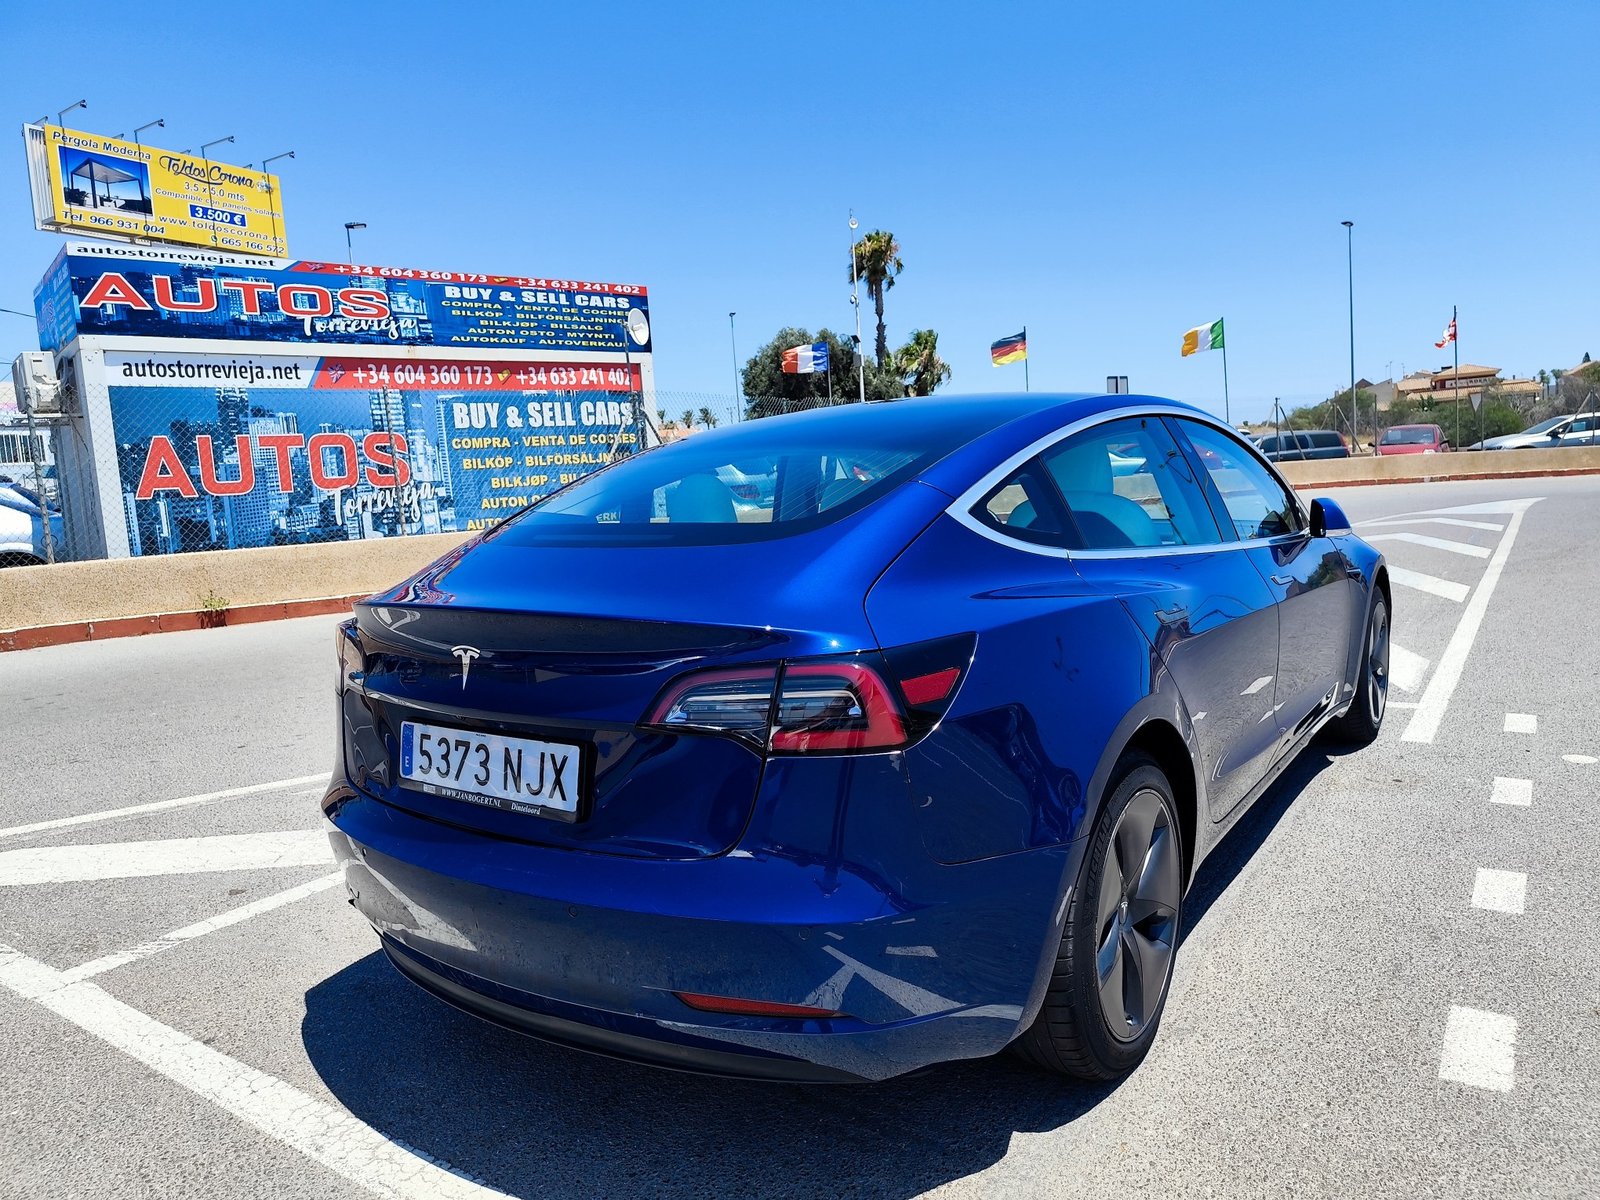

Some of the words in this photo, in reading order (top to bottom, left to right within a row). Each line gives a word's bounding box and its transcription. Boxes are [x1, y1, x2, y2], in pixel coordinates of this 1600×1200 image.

[53, 131, 99, 147] Pergola
[103, 142, 151, 160] Moderna
[159, 155, 206, 179] Toldos
[209, 166, 254, 189] Corona
[185, 181, 199, 192] 3.5
[210, 187, 225, 197] 5.0
[155, 187, 203, 202] Compatible
[205, 198, 220, 206] con
[222, 201, 252, 213] paneles
[254, 208, 281, 218] solares
[62, 210, 85, 222] Tel.
[90, 215, 113, 226] 966
[117, 219, 138, 230] 931
[143, 224, 165, 234] 004
[195, 206, 231, 223] 3.500
[233, 214, 243, 226] €
[159, 216, 284, 243] www.toldoscorona.es
[77, 246, 276, 267] autostorrevieja.net
[221, 237, 241, 247] 665
[245, 241, 263, 250] 166
[266, 245, 284, 254] 572
[334, 265, 375, 276] +34
[379, 267, 414, 278] 604
[419, 270, 452, 280] 360
[457, 273, 488, 283] 173
[514, 277, 547, 287] +34
[551, 280, 579, 289] 633
[583, 282, 609, 291] 241
[614, 285, 640, 294] 402
[79, 270, 390, 320] AUTOS
[441, 300, 502, 309] COMPRA
[514, 304, 558, 313] VENTA
[444, 286, 493, 301] BUY
[499, 290, 516, 302] &
[522, 291, 569, 305] SELL
[575, 294, 630, 309] CARS
[451, 309, 503, 318] BILKÖP
[480, 319, 538, 329] BILKJØP
[550, 323, 604, 331] BILSALG
[302, 315, 417, 340] Torrevieja
[468, 327, 516, 336] AUTON
[520, 329, 555, 337] OSTO
[567, 331, 614, 340] MYYNTI
[451, 335, 526, 344] AUTOKAUF
[122, 359, 301, 383] autostorrevieja.net
[353, 363, 390, 384] +34
[394, 364, 426, 385] 604
[429, 365, 460, 385] 360
[464, 365, 493, 385] 173
[516, 366, 547, 386] +34
[550, 367, 577, 386] 633
[580, 367, 604, 385] 241
[608, 367, 631, 386] 402
[452, 402, 499, 429] BUY
[506, 406, 523, 428] &
[527, 401, 576, 428] SELL
[580, 401, 633, 426] CARS
[452, 436, 511, 450] COMPRA
[522, 434, 566, 447] VENTA
[569, 434, 586, 445] DE
[135, 431, 411, 500] AUTOS
[463, 455, 513, 470] BILKÖP
[491, 474, 548, 489] BILKJØP
[331, 480, 435, 526] Torreveja
[481, 495, 528, 509] AUTON
[404, 756, 410, 767] E
[419, 733, 490, 787] 5373
[503, 746, 569, 802] NJX
